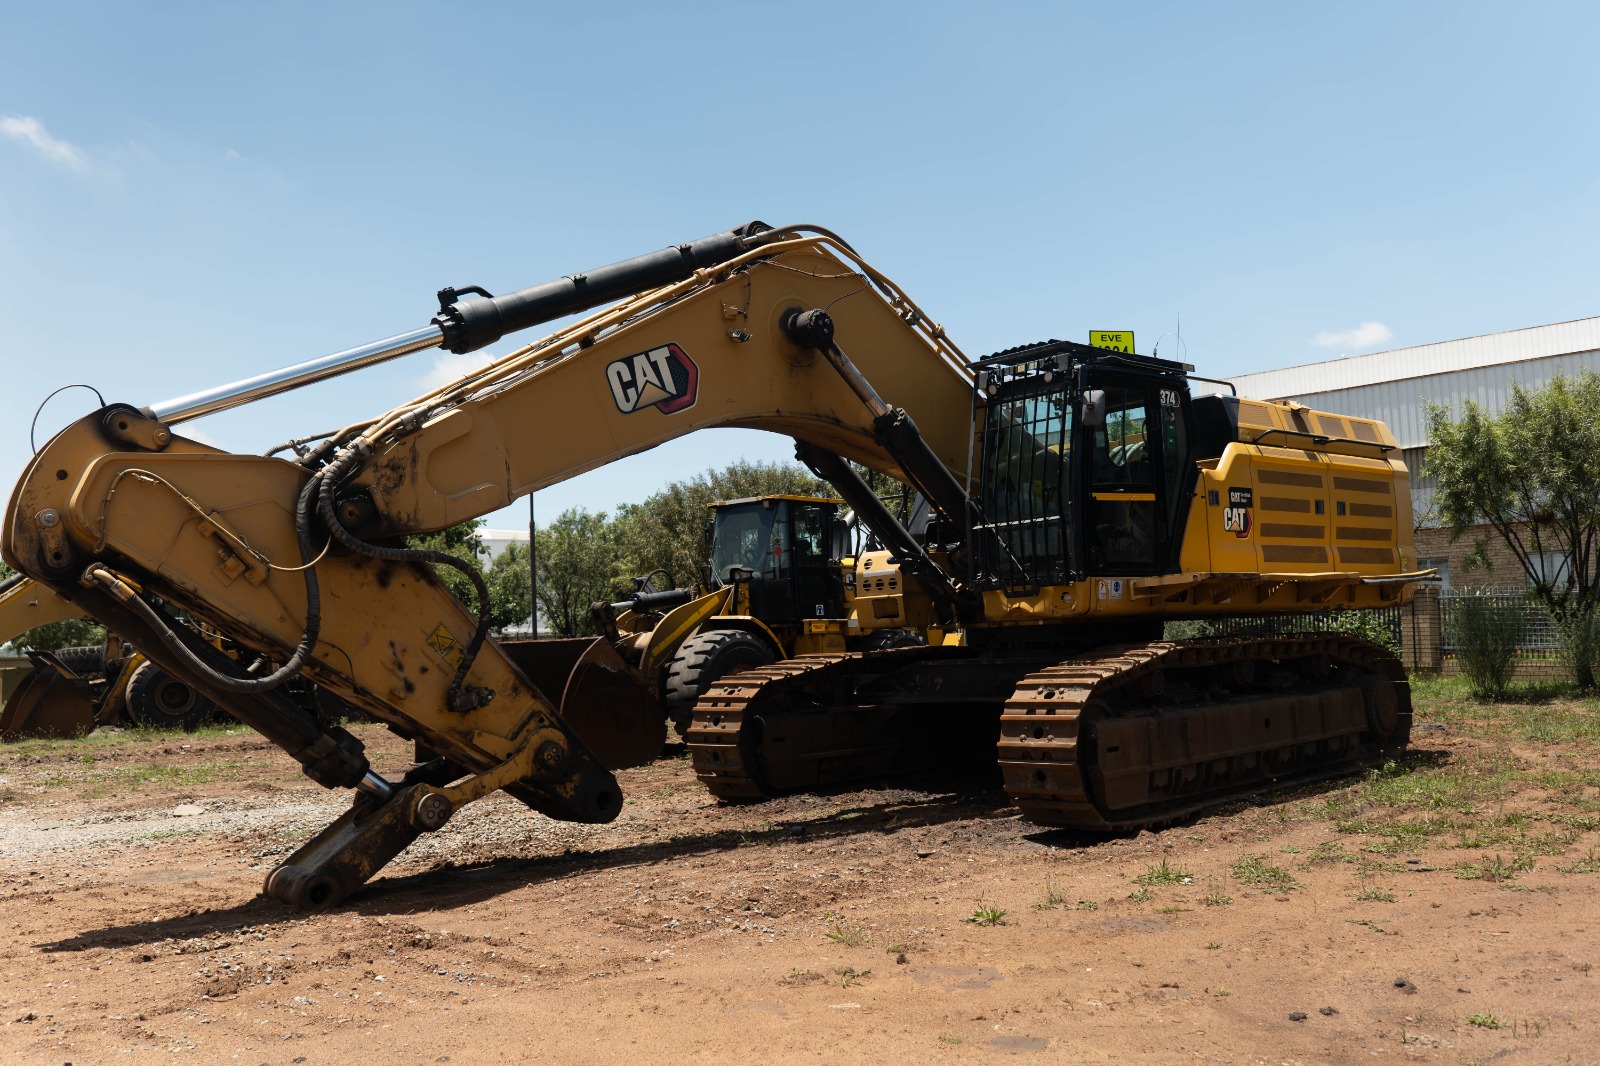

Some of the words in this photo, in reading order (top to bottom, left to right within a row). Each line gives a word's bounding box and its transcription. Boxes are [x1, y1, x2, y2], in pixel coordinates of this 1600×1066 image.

[1100, 334, 1122, 342] EVE
[606, 346, 678, 412] CAT
[1160, 389, 1176, 406] 374
[1230, 491, 1240, 502] CAT
[1223, 507, 1246, 531] CAT
